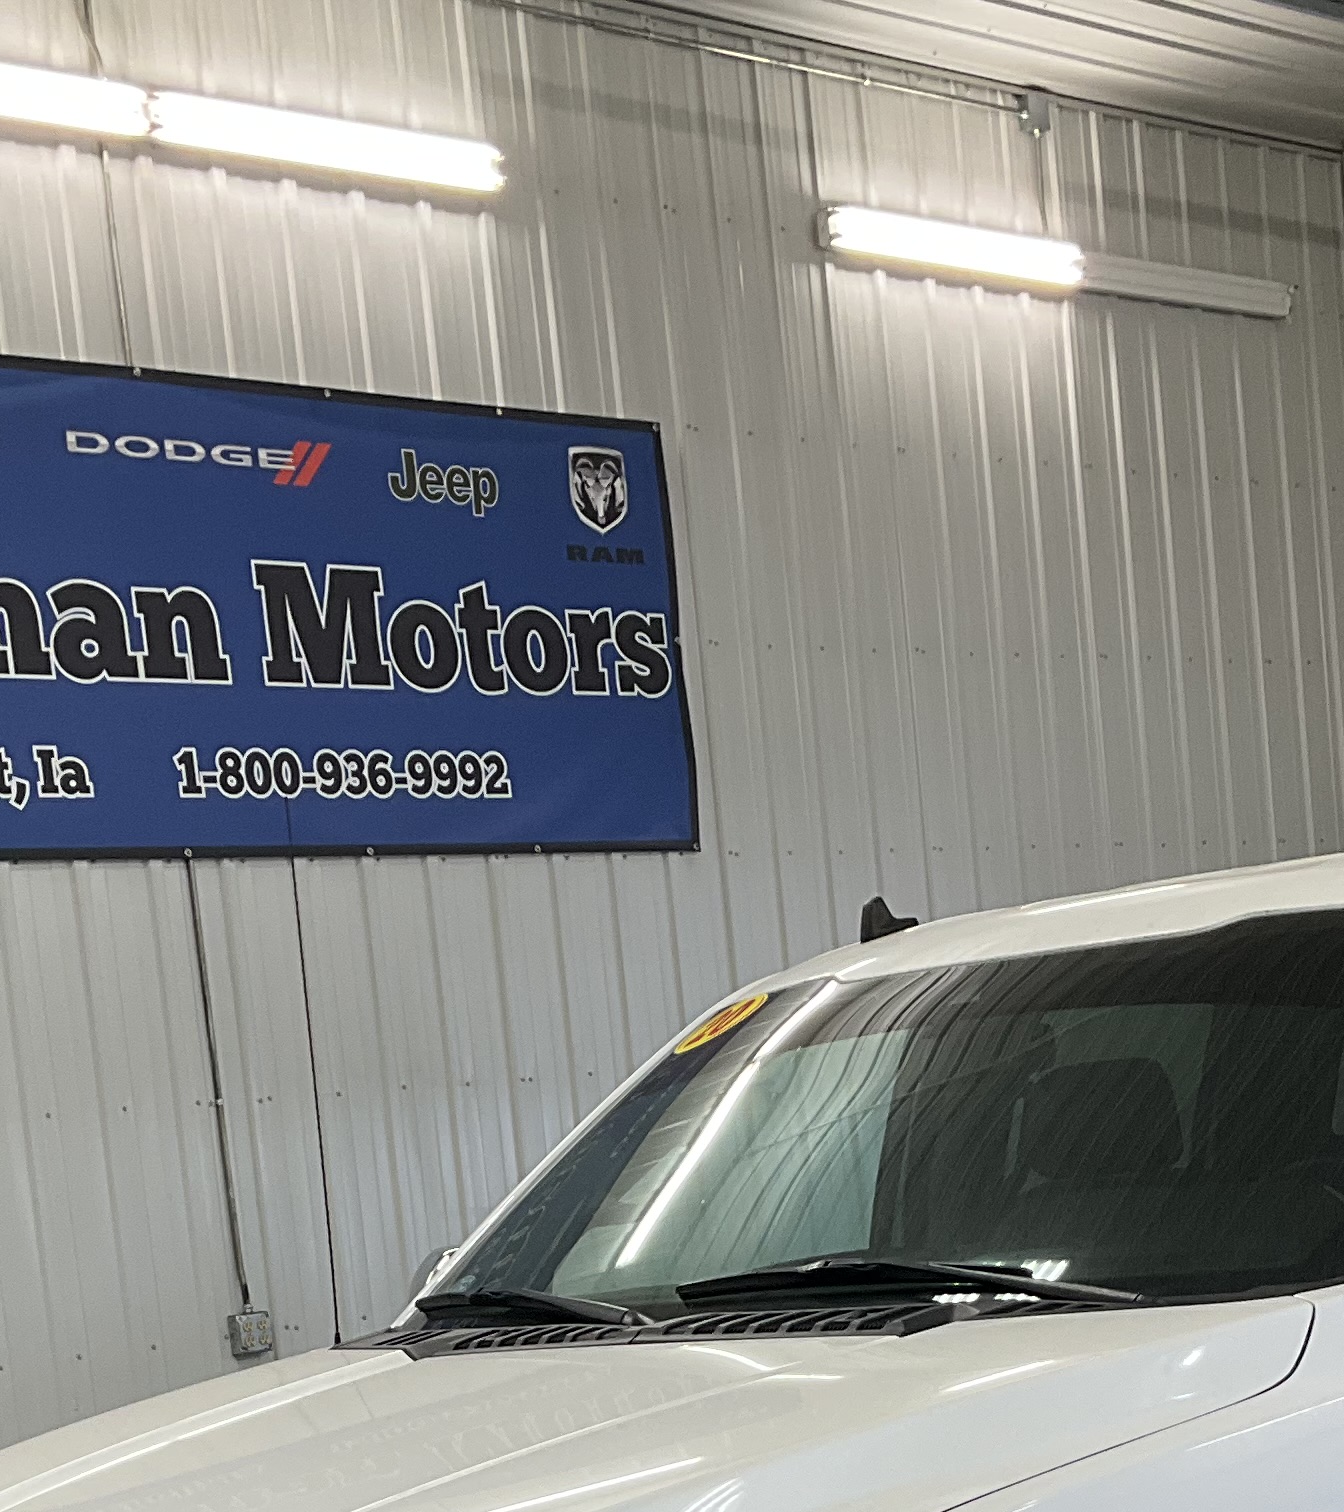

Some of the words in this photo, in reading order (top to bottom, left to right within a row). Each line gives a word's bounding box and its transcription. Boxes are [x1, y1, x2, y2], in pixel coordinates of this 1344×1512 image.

[65, 431, 296, 471] DODGE
[388, 449, 499, 517] Jeep
[566, 544, 645, 565] RAM
[250, 559, 672, 699] Motors
[33, 744, 94, 799] Ia
[173, 747, 512, 799] 1-800-936-9992
